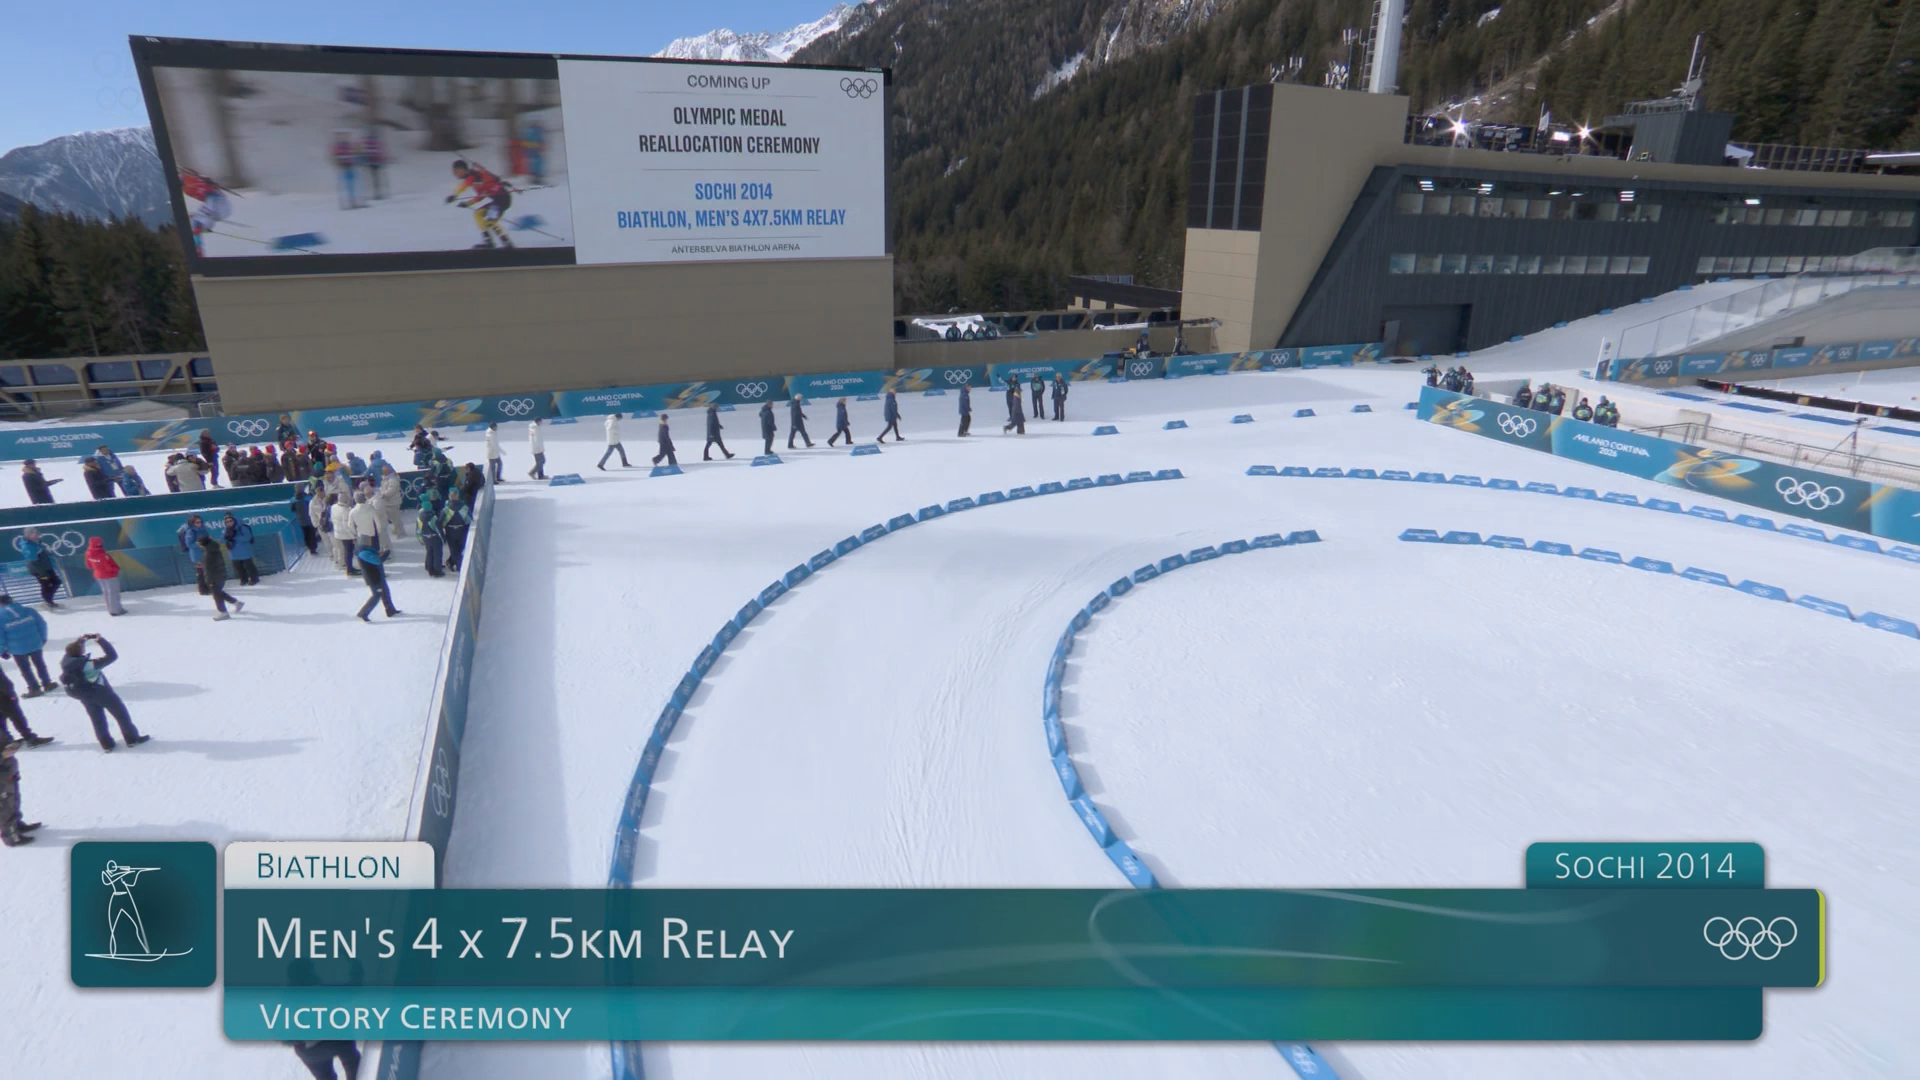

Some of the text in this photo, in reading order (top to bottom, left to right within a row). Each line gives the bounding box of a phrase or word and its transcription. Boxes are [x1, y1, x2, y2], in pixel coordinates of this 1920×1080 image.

[687, 74, 771, 90] COMING UP
[673, 107, 786, 127] OLYMPIC MEDAL
[639, 134, 820, 154] REALLOCATION CEREMONY
[694, 182, 773, 201] SOCHI 2014
[617, 208, 846, 230] BIATHLON, MEN'S 4X7.5KM RELAY
[671, 243, 801, 255] ANTERSELVA BIATHLON ARENA
[581, 392, 644, 403] MILANO CORTINA
[323, 411, 395, 423] MILANO CORTINA
[1572, 433, 1650, 458] MILANO CORTINA
[1598, 446, 1618, 458] 2026
[243, 514, 289, 527] ORTINA
